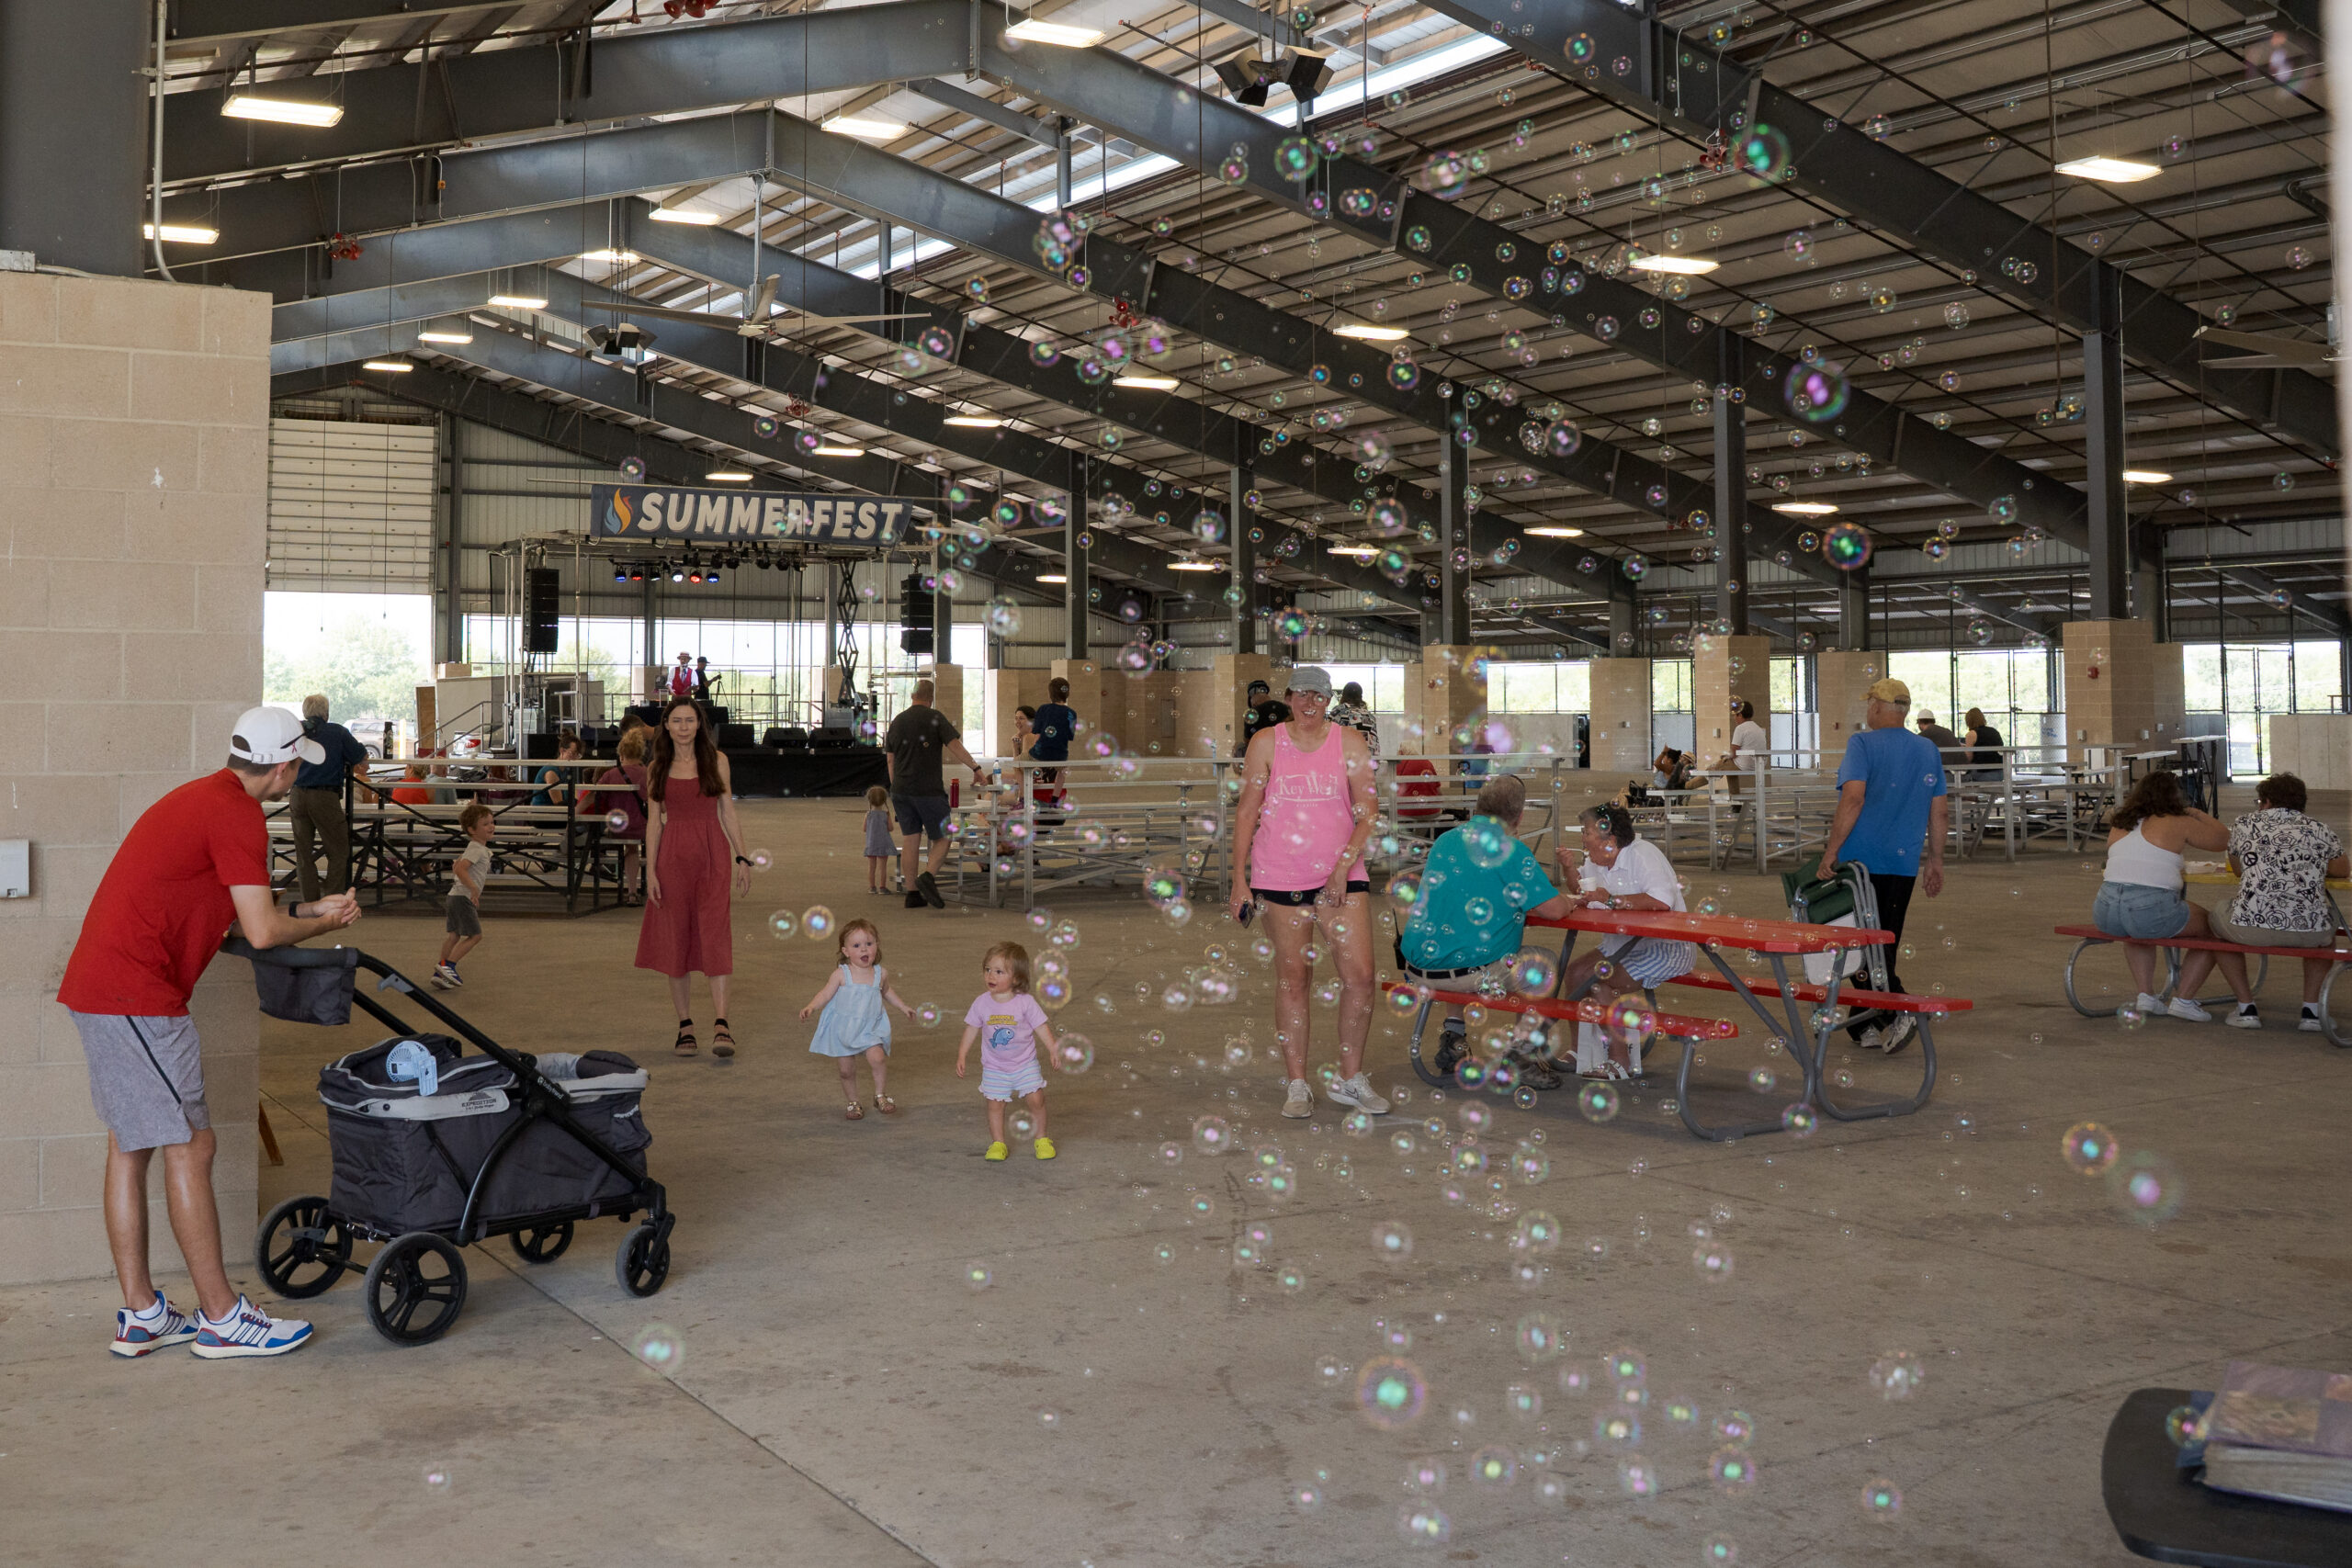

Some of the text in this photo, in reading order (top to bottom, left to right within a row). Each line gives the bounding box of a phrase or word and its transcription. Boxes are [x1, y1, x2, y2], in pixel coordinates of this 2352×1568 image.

[637, 492, 903, 540] SUMMERFEST
[1275, 775, 1304, 796] Key
[2279, 852, 2322, 869] BROKEN
[2271, 882, 2288, 891] HEY
[462, 1098, 506, 1108] EXPEDITION
